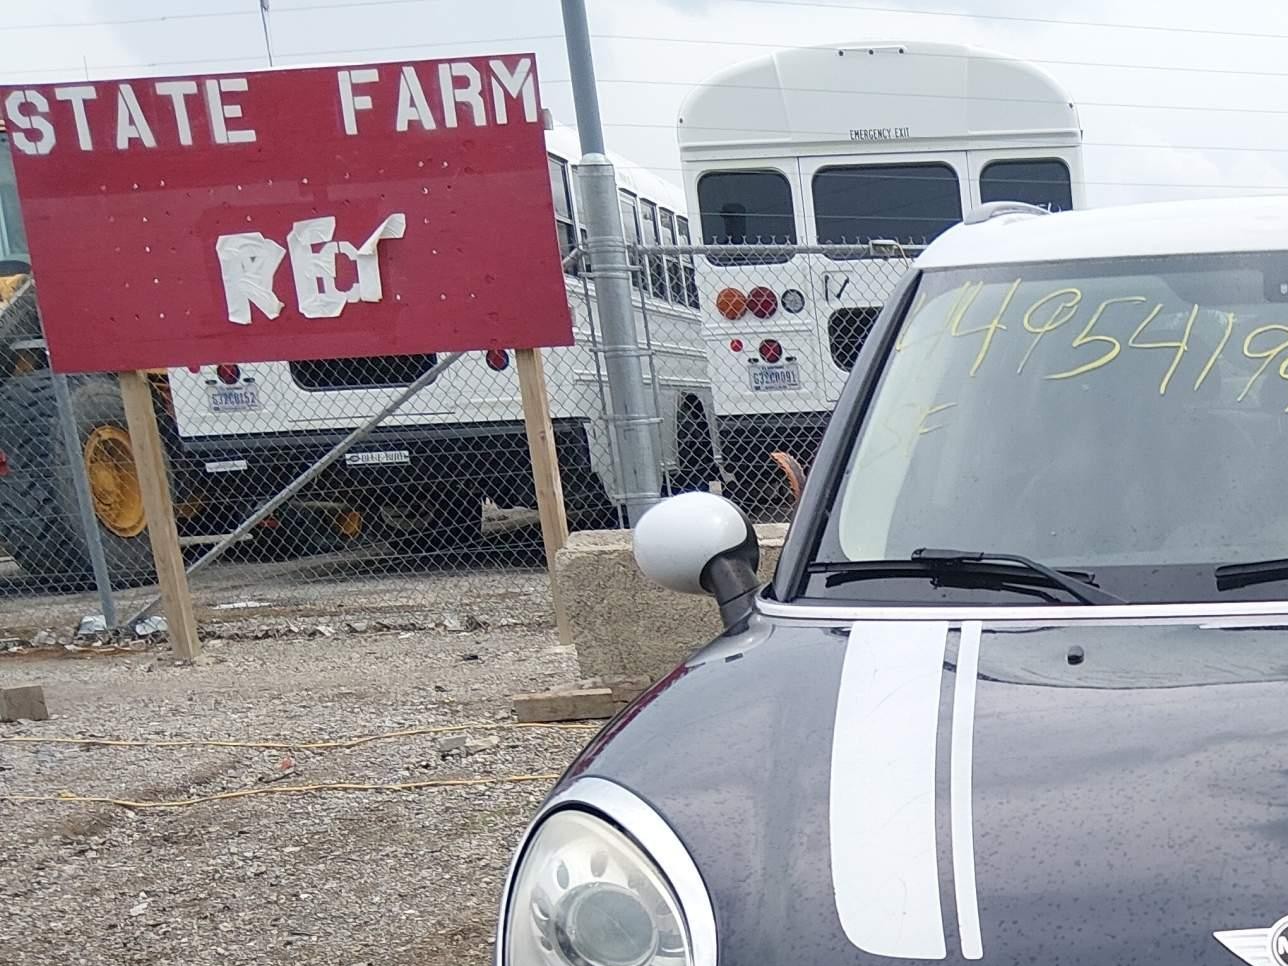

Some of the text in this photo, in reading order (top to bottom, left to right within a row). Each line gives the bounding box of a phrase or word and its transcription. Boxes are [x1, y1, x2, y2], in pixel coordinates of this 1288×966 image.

[5, 58, 538, 155] STATE FARM
[849, 126, 911, 141] EMERGENCY EXIT
